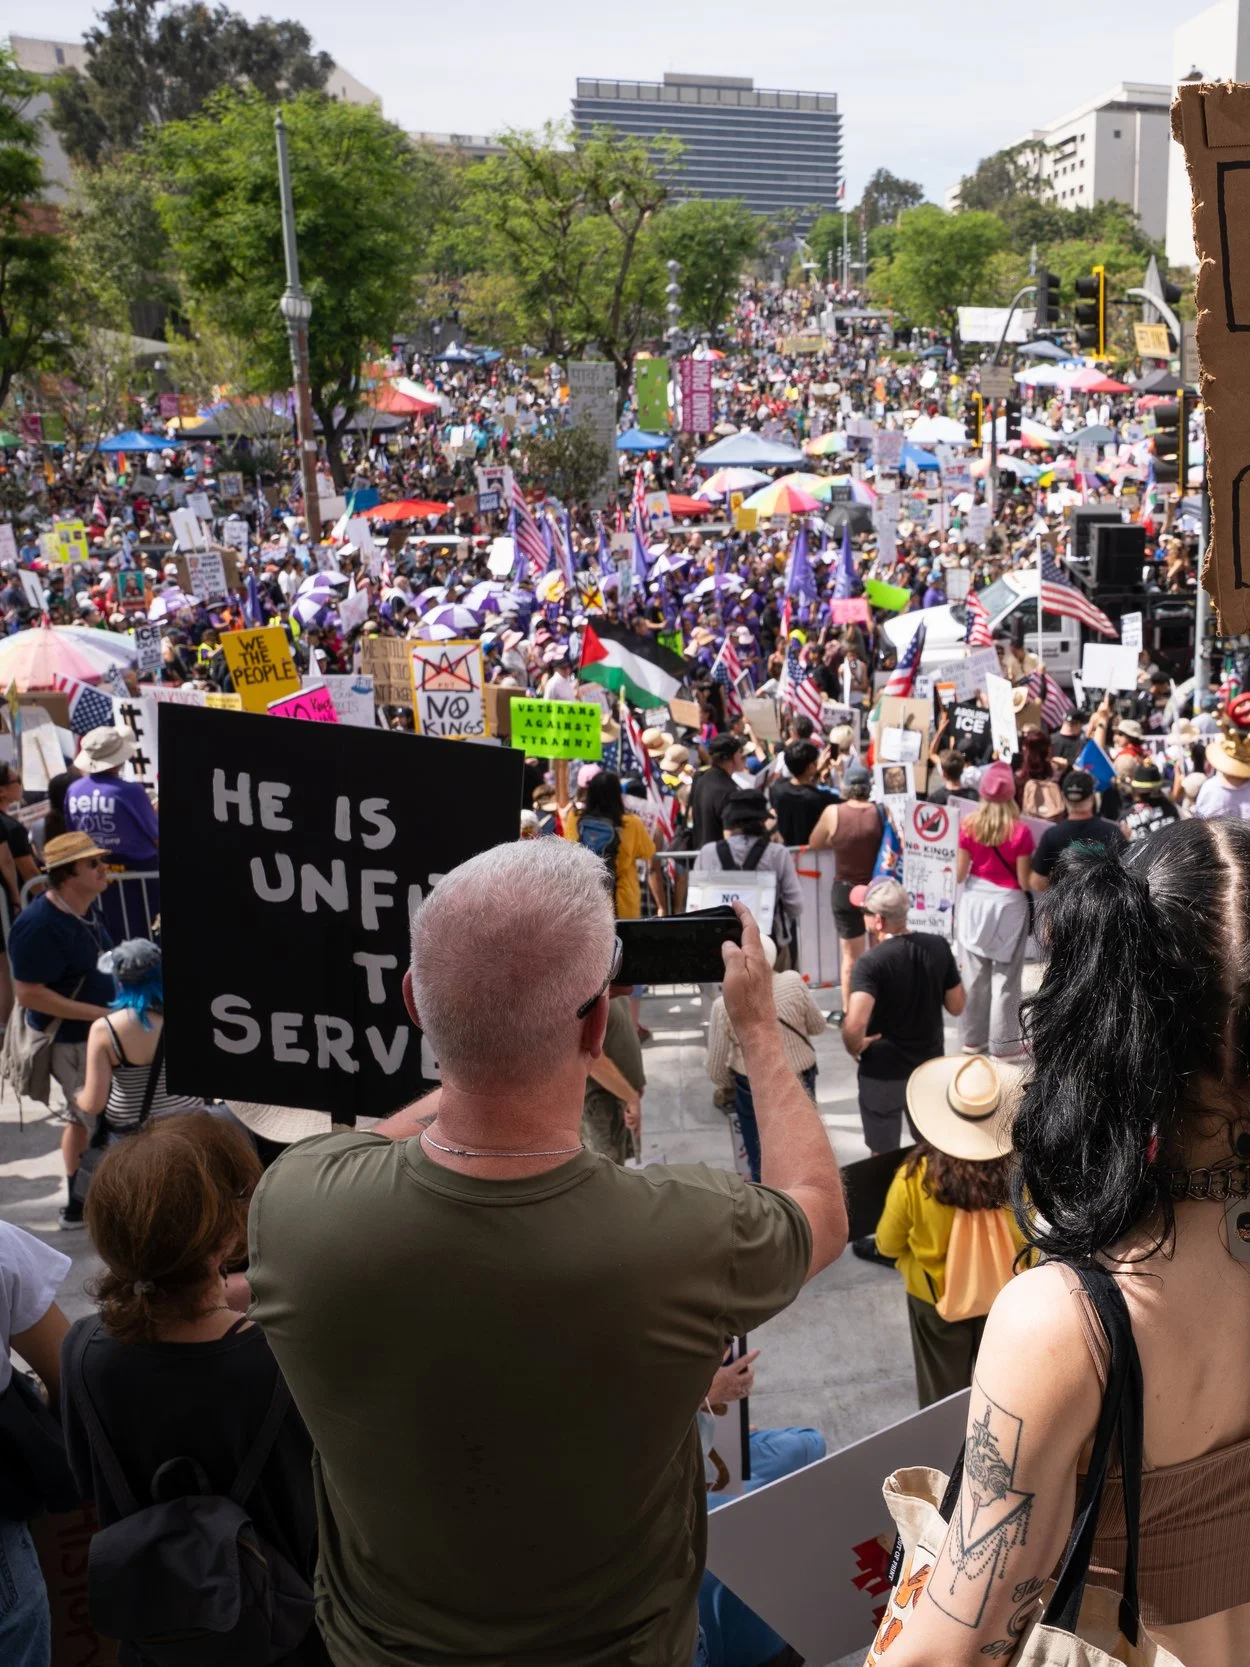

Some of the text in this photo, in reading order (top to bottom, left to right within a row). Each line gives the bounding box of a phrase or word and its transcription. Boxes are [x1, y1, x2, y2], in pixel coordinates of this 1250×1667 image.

[692, 361, 711, 431] GRAND PARK
[136, 627, 160, 642] ICE
[238, 635, 267, 652] WE
[239, 650, 271, 666] THE
[233, 660, 297, 687] PEOPLE
[426, 695, 470, 720] NO
[517, 703, 596, 717] VETERANS
[954, 706, 990, 722] ABOLISH
[422, 719, 485, 736] KINGS
[524, 718, 593, 733] AGAINST
[955, 716, 986, 735] ICE
[520, 735, 593, 749] TYRANNY
[69, 789, 116, 814] seiu
[212, 767, 397, 850] HE IS
[72, 814, 117, 833] 2015
[905, 840, 920, 852] NO
[923, 844, 956, 858] KINGS
[250, 852, 450, 931] UNFI
[722, 893, 740, 903] NO
[353, 951, 398, 1004] T
[887, 1536, 904, 1582] OUT OF PRINT
